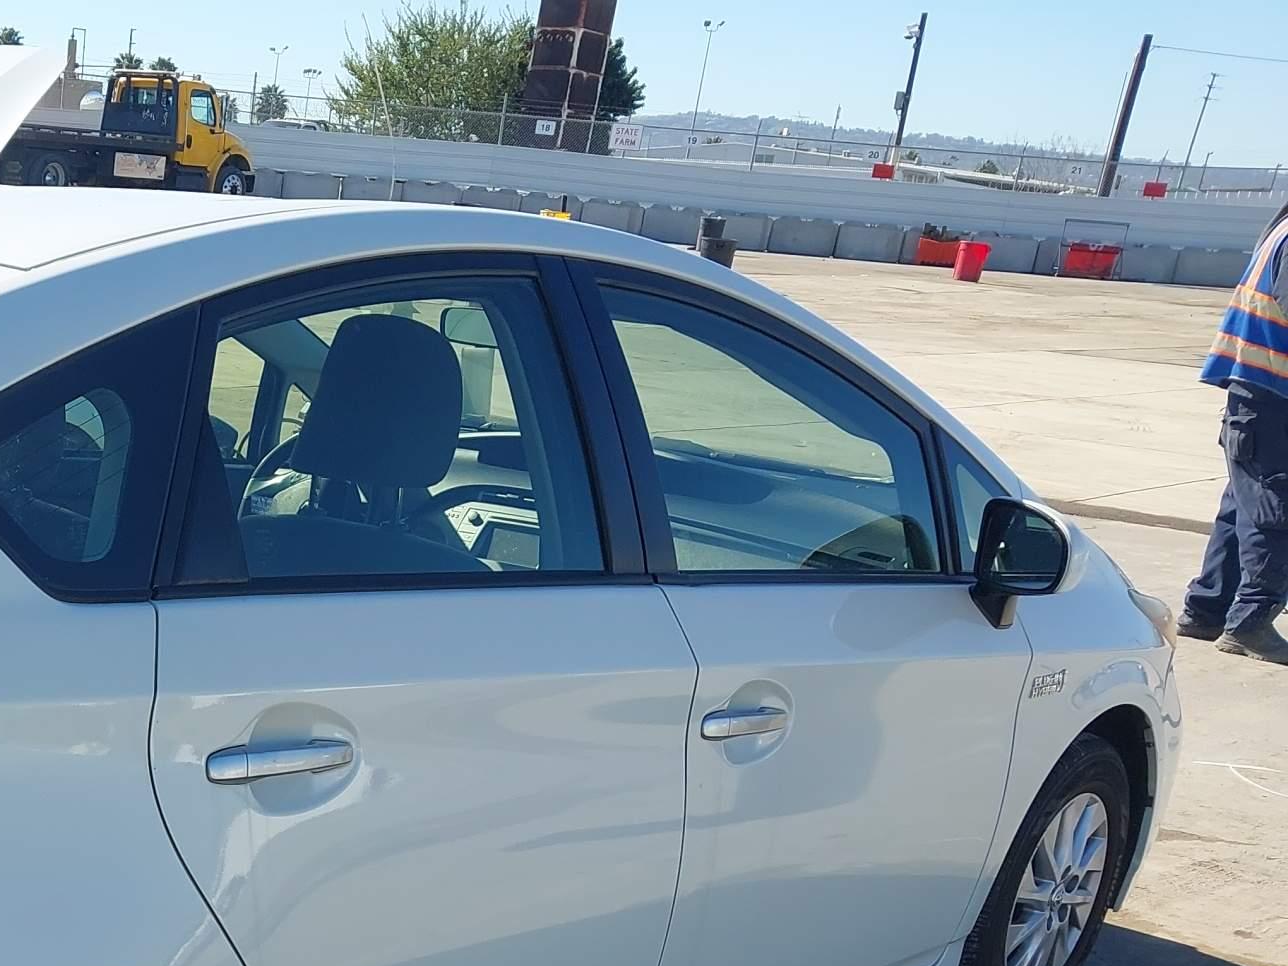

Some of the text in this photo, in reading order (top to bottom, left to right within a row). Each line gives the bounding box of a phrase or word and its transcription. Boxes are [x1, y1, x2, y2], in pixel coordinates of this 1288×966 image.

[541, 124, 551, 132] 18
[615, 127, 639, 136] STATE
[614, 138, 636, 146] FARM
[688, 136, 697, 145] 19
[868, 151, 880, 159] 20
[1071, 167, 1082, 175] 21
